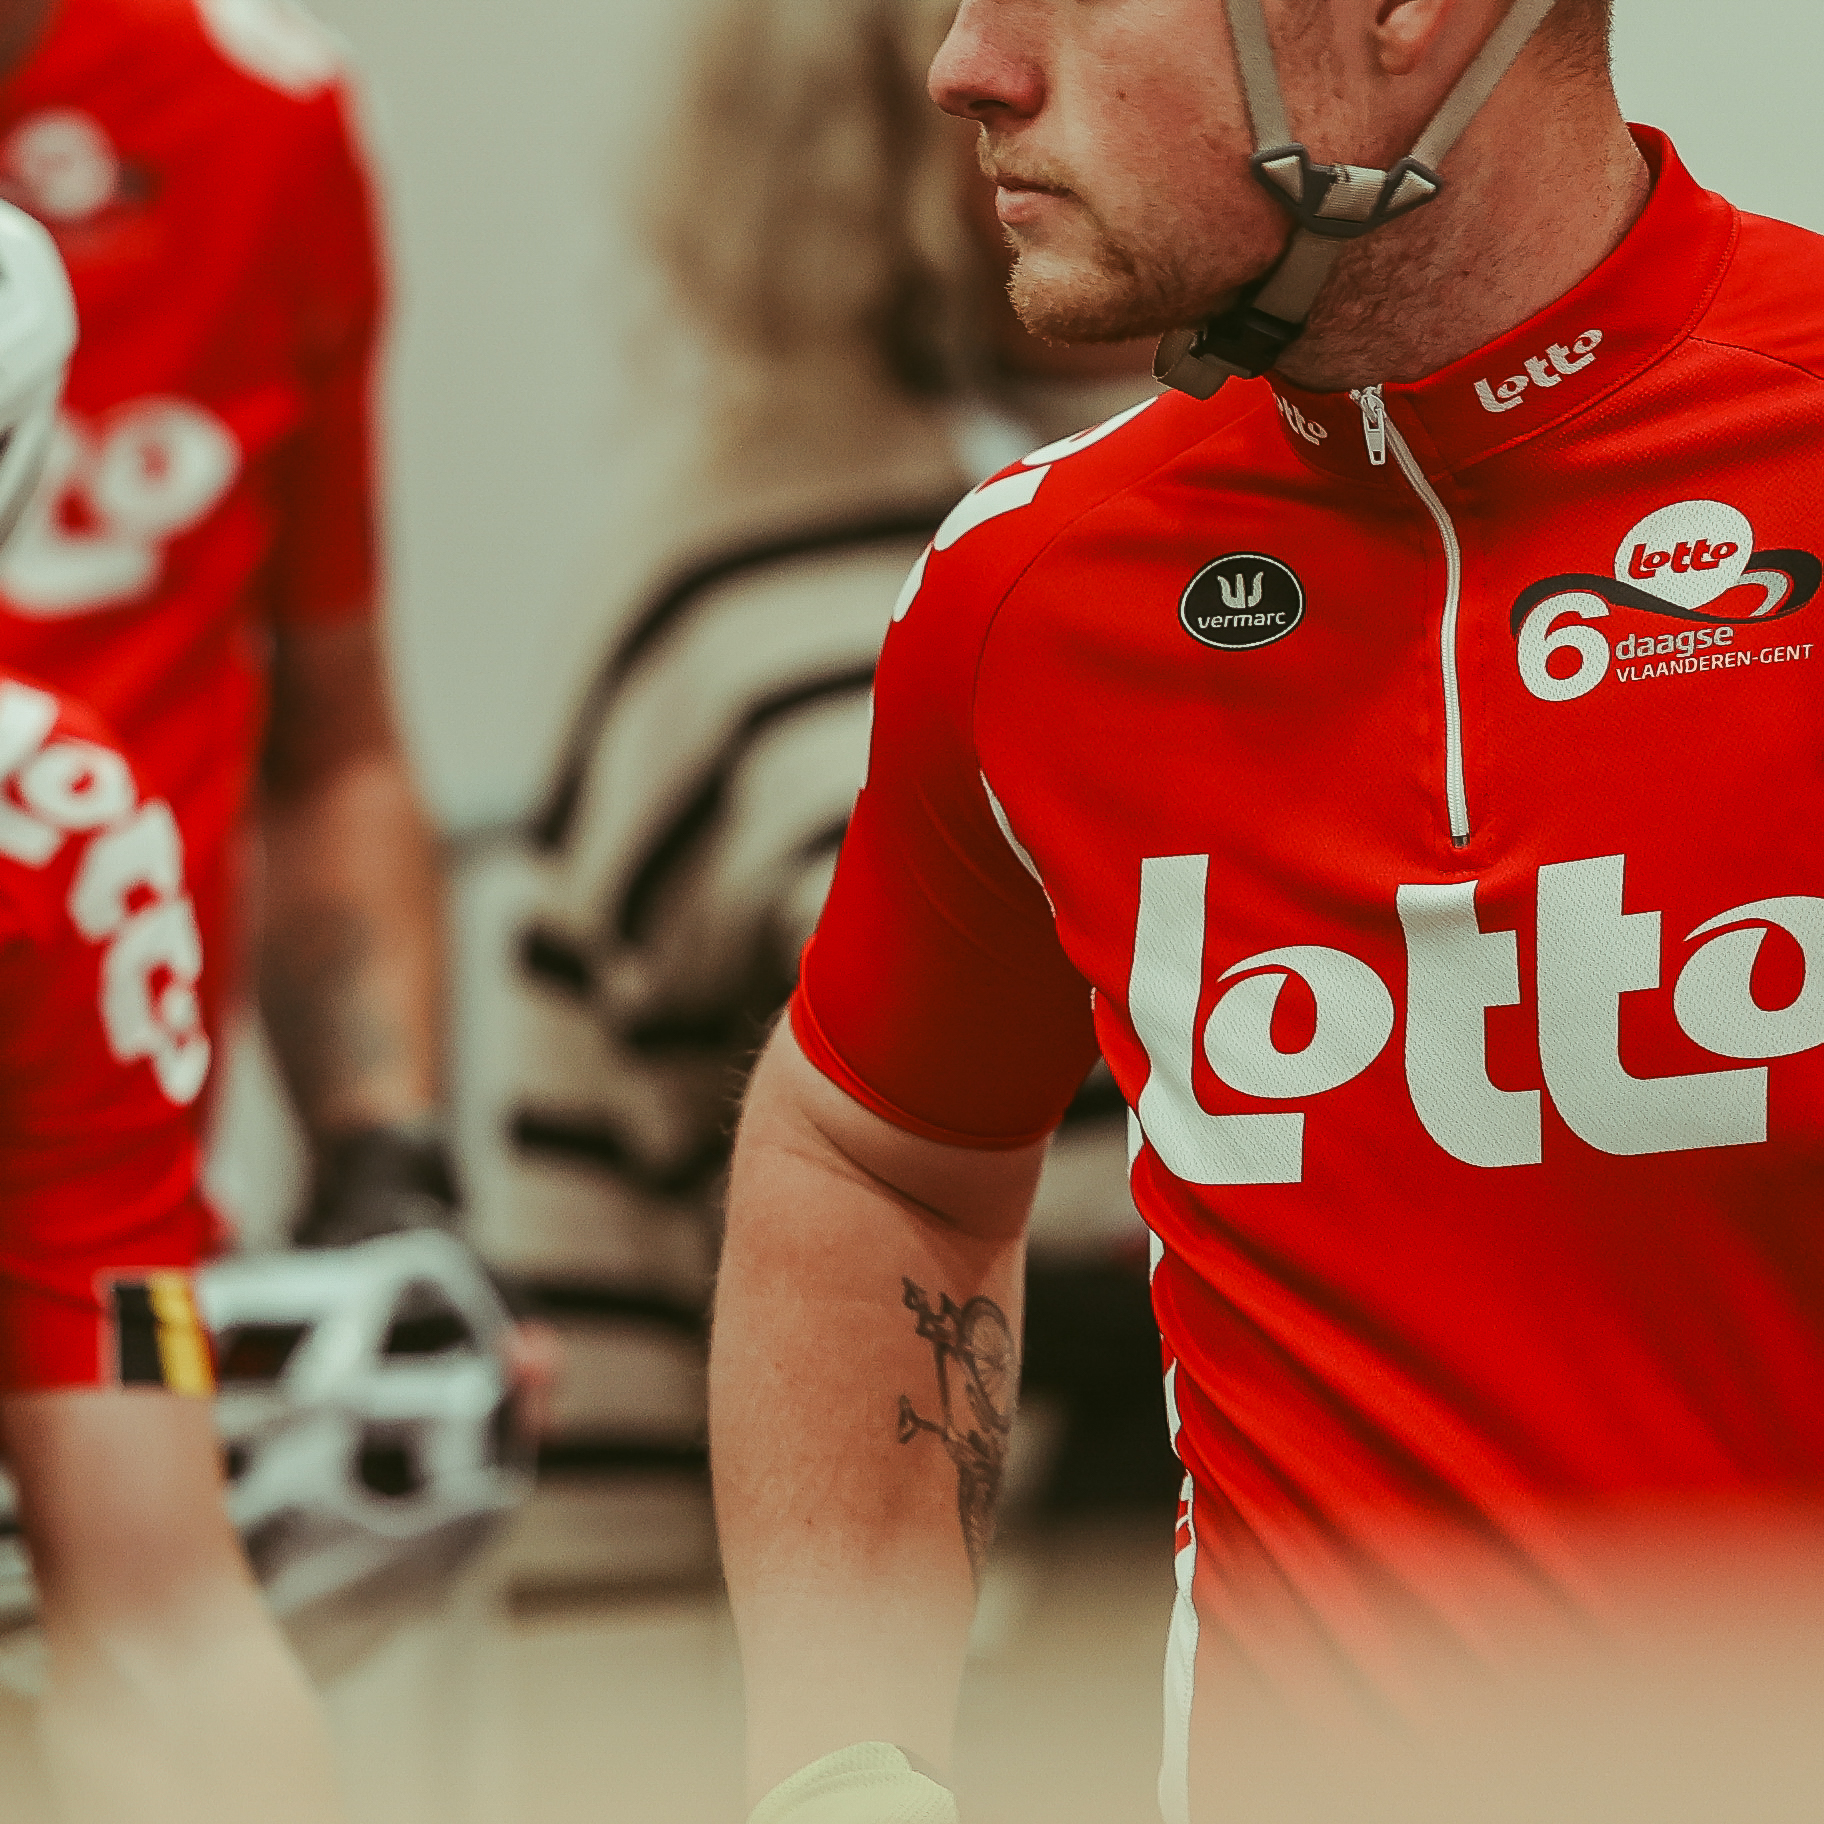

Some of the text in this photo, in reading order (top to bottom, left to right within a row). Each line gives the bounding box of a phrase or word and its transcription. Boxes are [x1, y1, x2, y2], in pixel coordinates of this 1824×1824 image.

[1272, 392, 1328, 446] tto
[1197, 611, 1286, 629] vermarc
[1516, 591, 1735, 702] 6 daagse
[1615, 643, 1815, 683] VLAANDEREN-GENT
